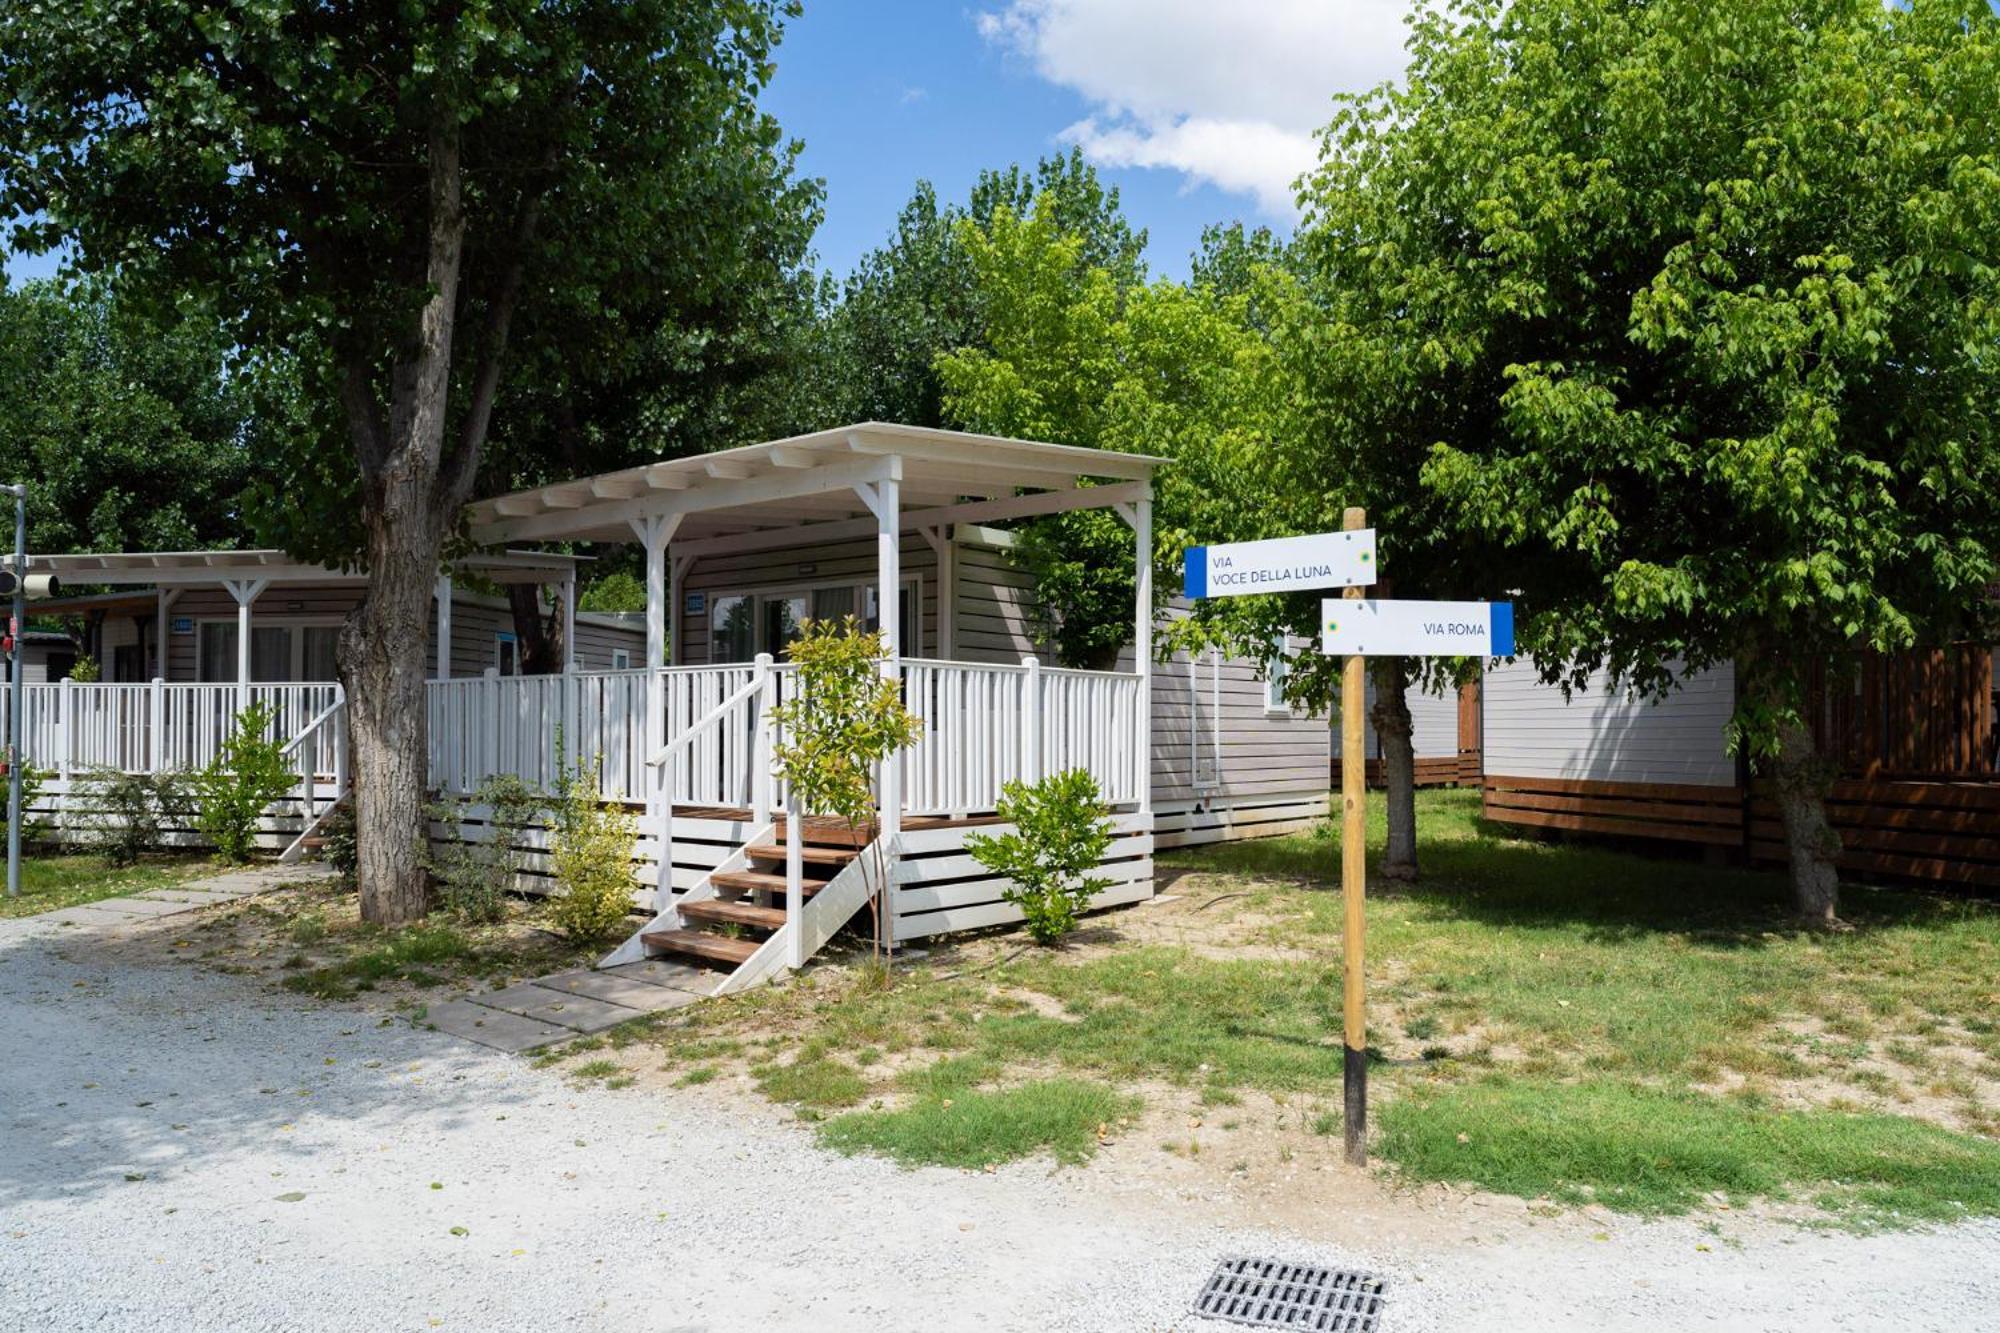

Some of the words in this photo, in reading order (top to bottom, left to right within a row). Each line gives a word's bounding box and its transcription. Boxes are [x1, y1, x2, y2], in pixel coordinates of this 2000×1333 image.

[1213, 556, 1232, 569] VIA
[1213, 572, 1247, 585] VOCE
[1251, 568, 1291, 583] DELLA
[1295, 565, 1332, 579] LUNA
[1423, 622, 1444, 635] VIA
[1448, 622, 1485, 635] ROMA
